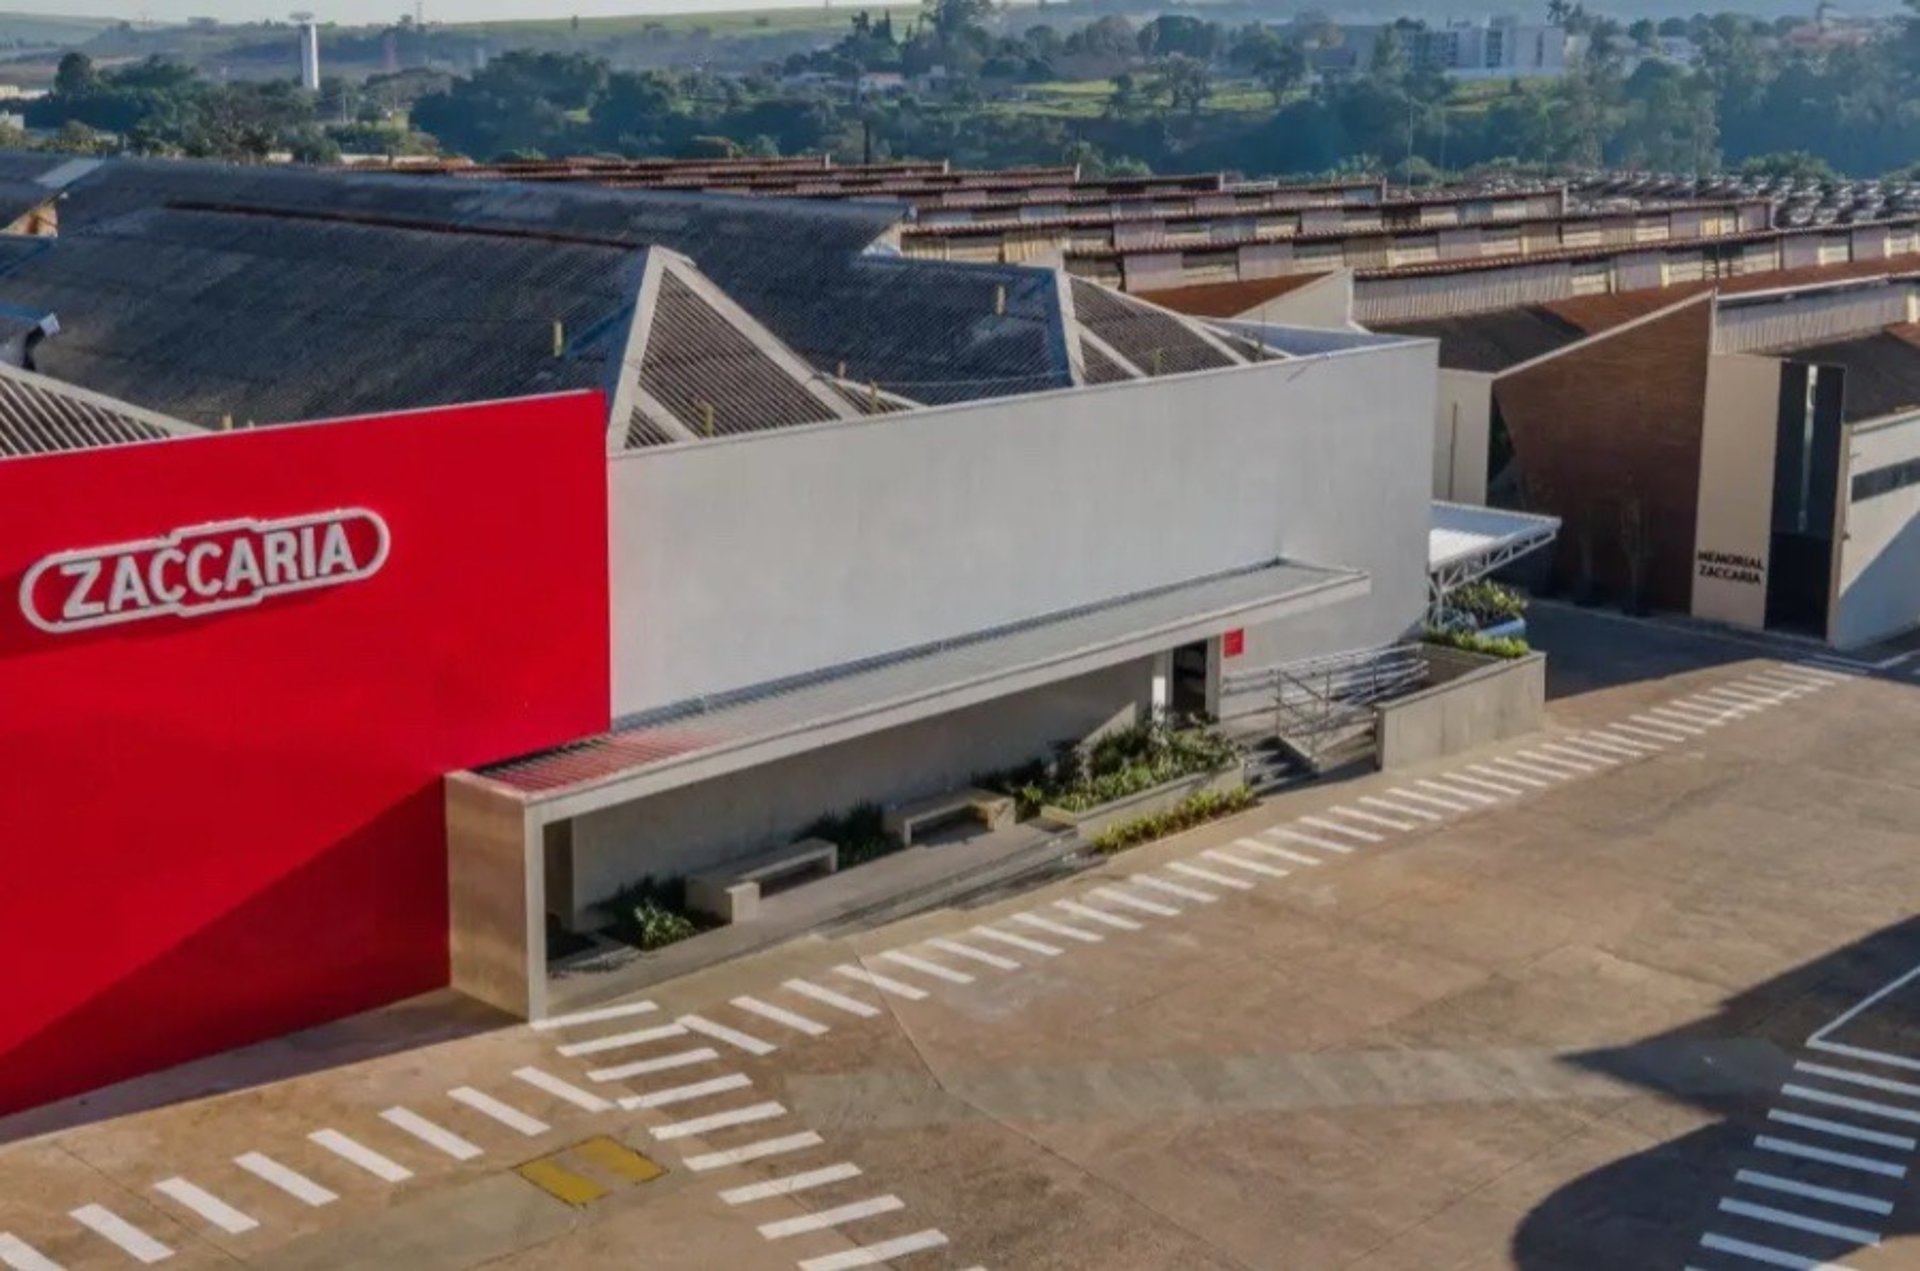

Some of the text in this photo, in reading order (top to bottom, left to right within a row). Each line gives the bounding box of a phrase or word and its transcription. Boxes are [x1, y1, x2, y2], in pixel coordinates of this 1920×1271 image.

[60, 522, 357, 619] ZACCARIA
[1698, 552, 1764, 571] MEMORIAL
[1699, 564, 1761, 585] ZACCARIA
